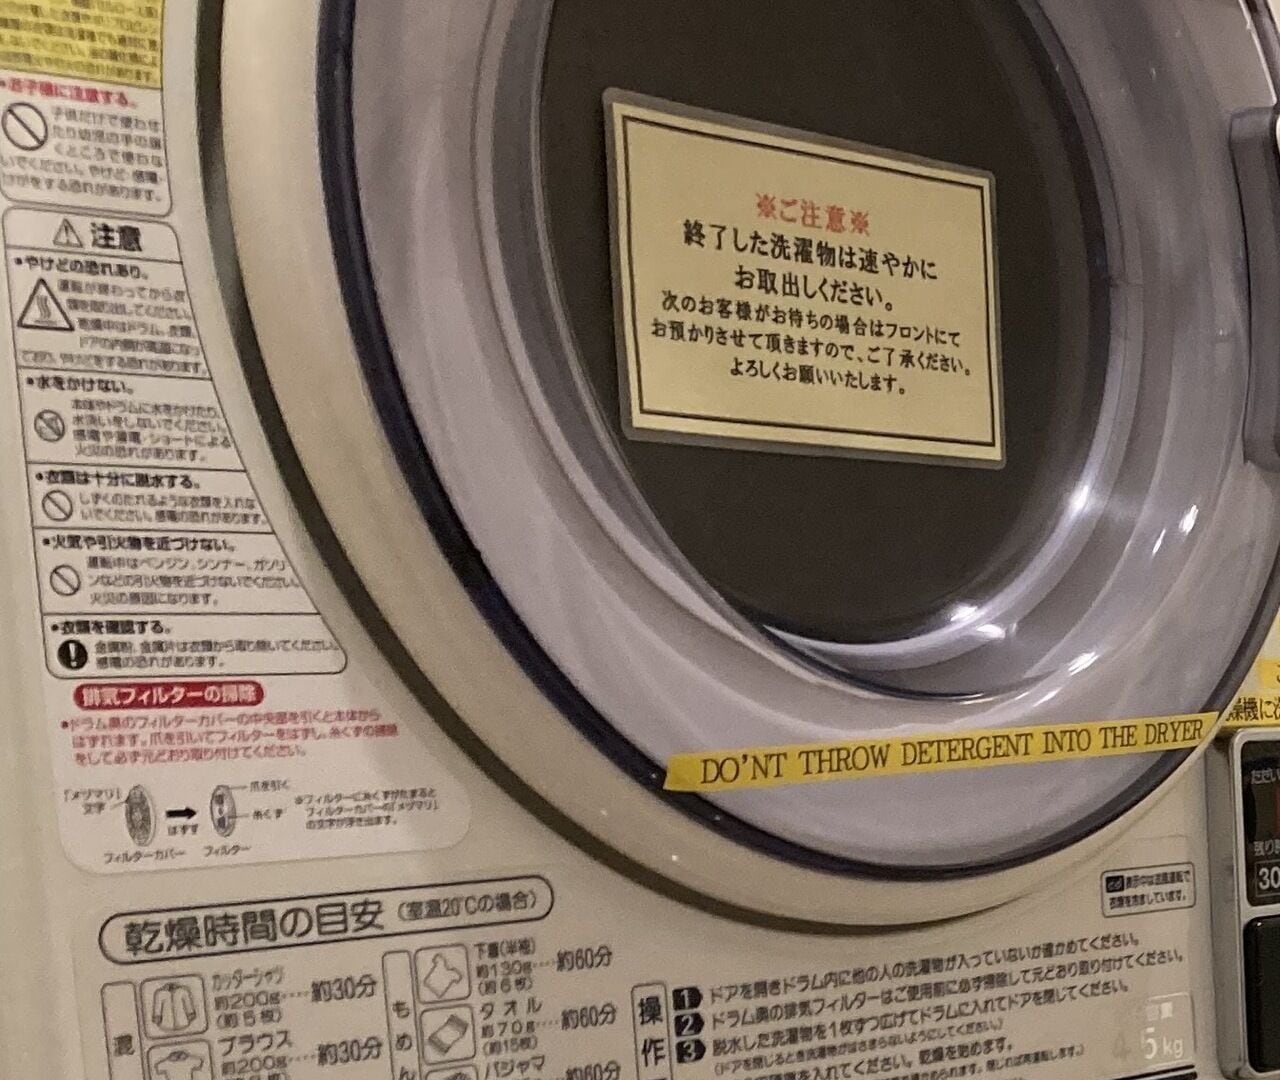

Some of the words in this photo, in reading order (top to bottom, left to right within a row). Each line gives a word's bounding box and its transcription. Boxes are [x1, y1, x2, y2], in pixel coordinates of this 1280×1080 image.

[91, 221, 143, 252] 注意
[683, 219, 938, 280] 終了した洗濯物は速やかに
[735, 265, 894, 312] お取出しください。
[661, 290, 961, 348] 次のお客様がお待ちの場合はフロントにて
[651, 319, 972, 376] お預かりさせて頂きますので、ご了承ください。
[730, 358, 906, 395] よろしくお願いいたします。
[700, 752, 788, 784] DO'NT
[797, 743, 891, 776] THROW
[900, 732, 1034, 766] DETERGENT
[1041, 728, 1093, 754] INTO
[1099, 724, 1138, 749] THE
[1144, 718, 1204, 745] DRYER
[124, 898, 385, 956] 乾燥時間の目安
[311, 974, 377, 1003] 約30分
[217, 1030, 293, 1056] ブラウス
[317, 1036, 381, 1067] 約30分
